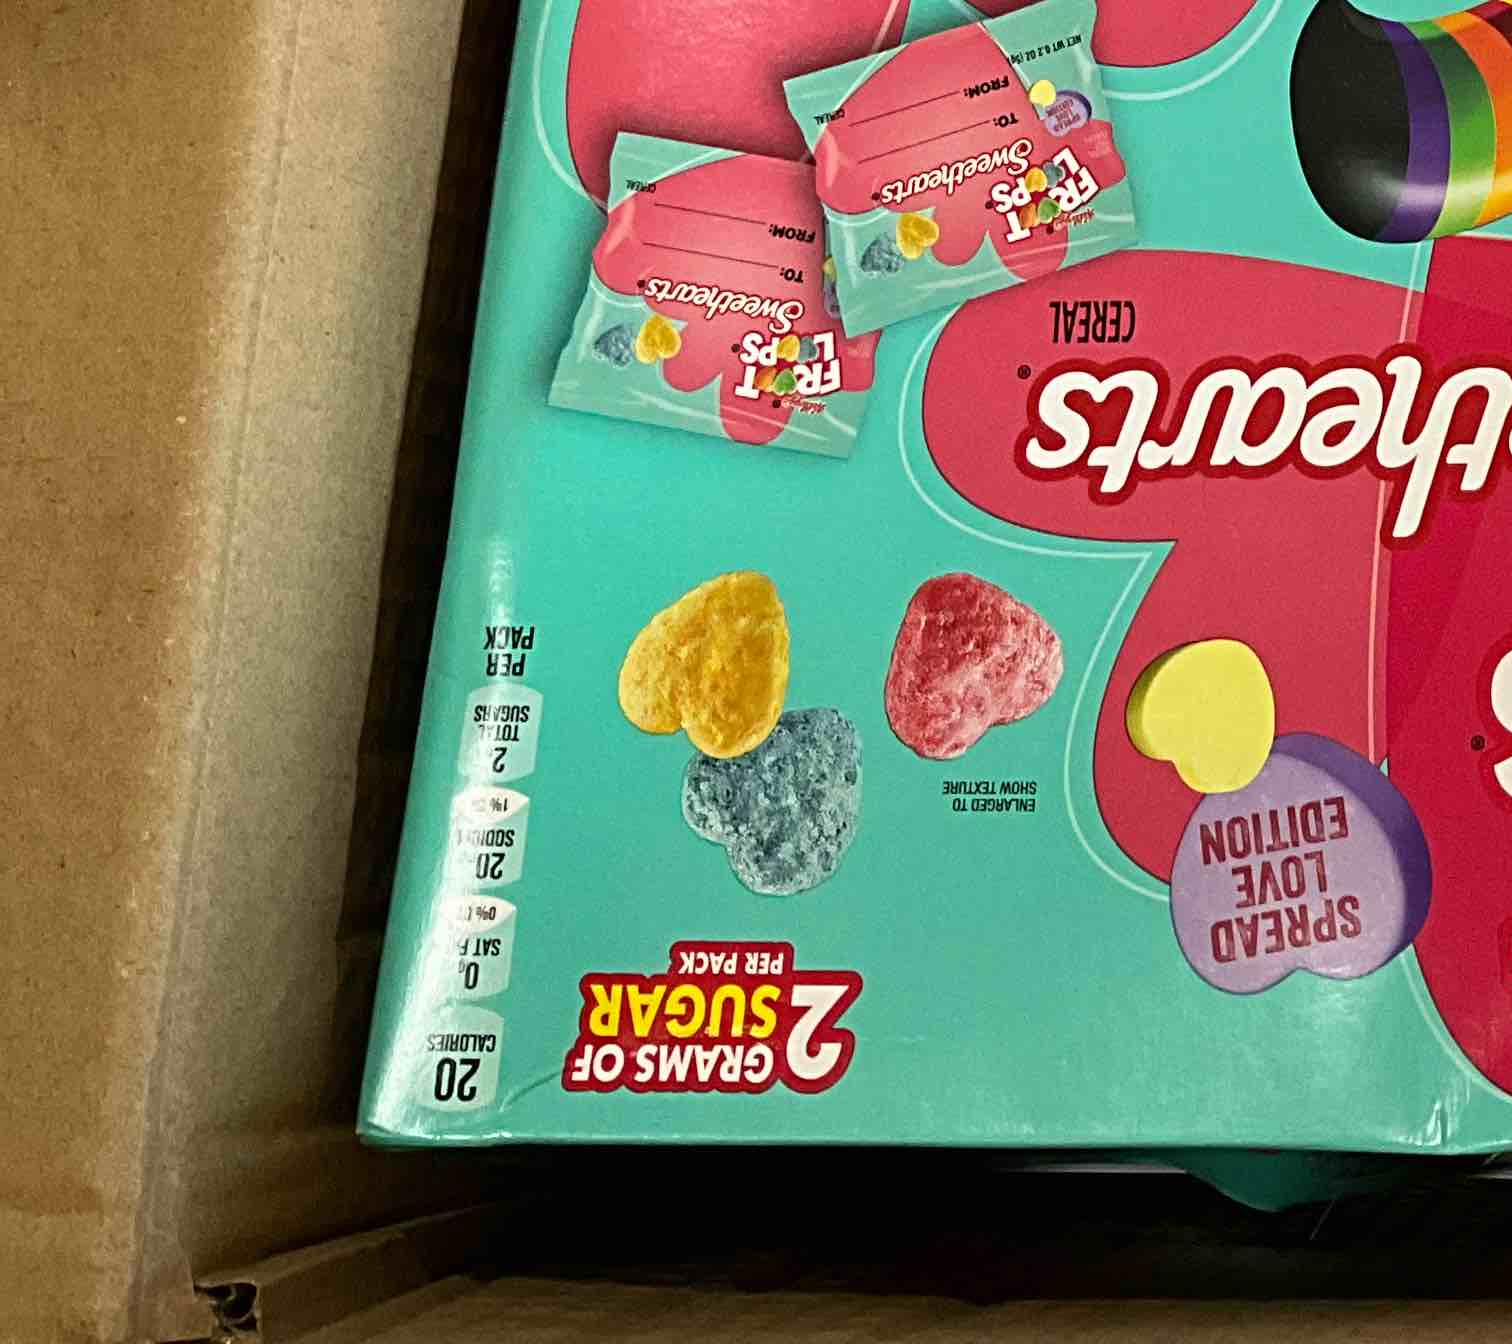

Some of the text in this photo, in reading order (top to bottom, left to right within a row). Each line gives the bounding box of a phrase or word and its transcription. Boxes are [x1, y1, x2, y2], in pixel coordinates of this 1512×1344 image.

[962, 75, 1010, 99] FROM:
[992, 112, 1019, 128] TO:
[880, 137, 1034, 205] Sweethearts
[767, 222, 817, 244] FROM:
[779, 267, 804, 284] TO:
[647, 276, 806, 337] Sweethearts
[1048, 298, 1138, 345] CEREAL
[483, 625, 535, 651] PACK
[485, 653, 527, 677] PER
[942, 779, 1039, 796] SHOW TEXTURE
[952, 796, 1037, 813] ENLARGED TO
[1199, 795, 1350, 866] EDITION
[1230, 850, 1329, 910] LOVE
[1210, 894, 1363, 964] SPREAD
[677, 950, 785, 976] PER PACK
[588, 983, 783, 1039] SUGAR
[785, 984, 850, 1082] 2
[433, 1057, 482, 1102] 20
[571, 1043, 775, 1084] GRAMS OF
